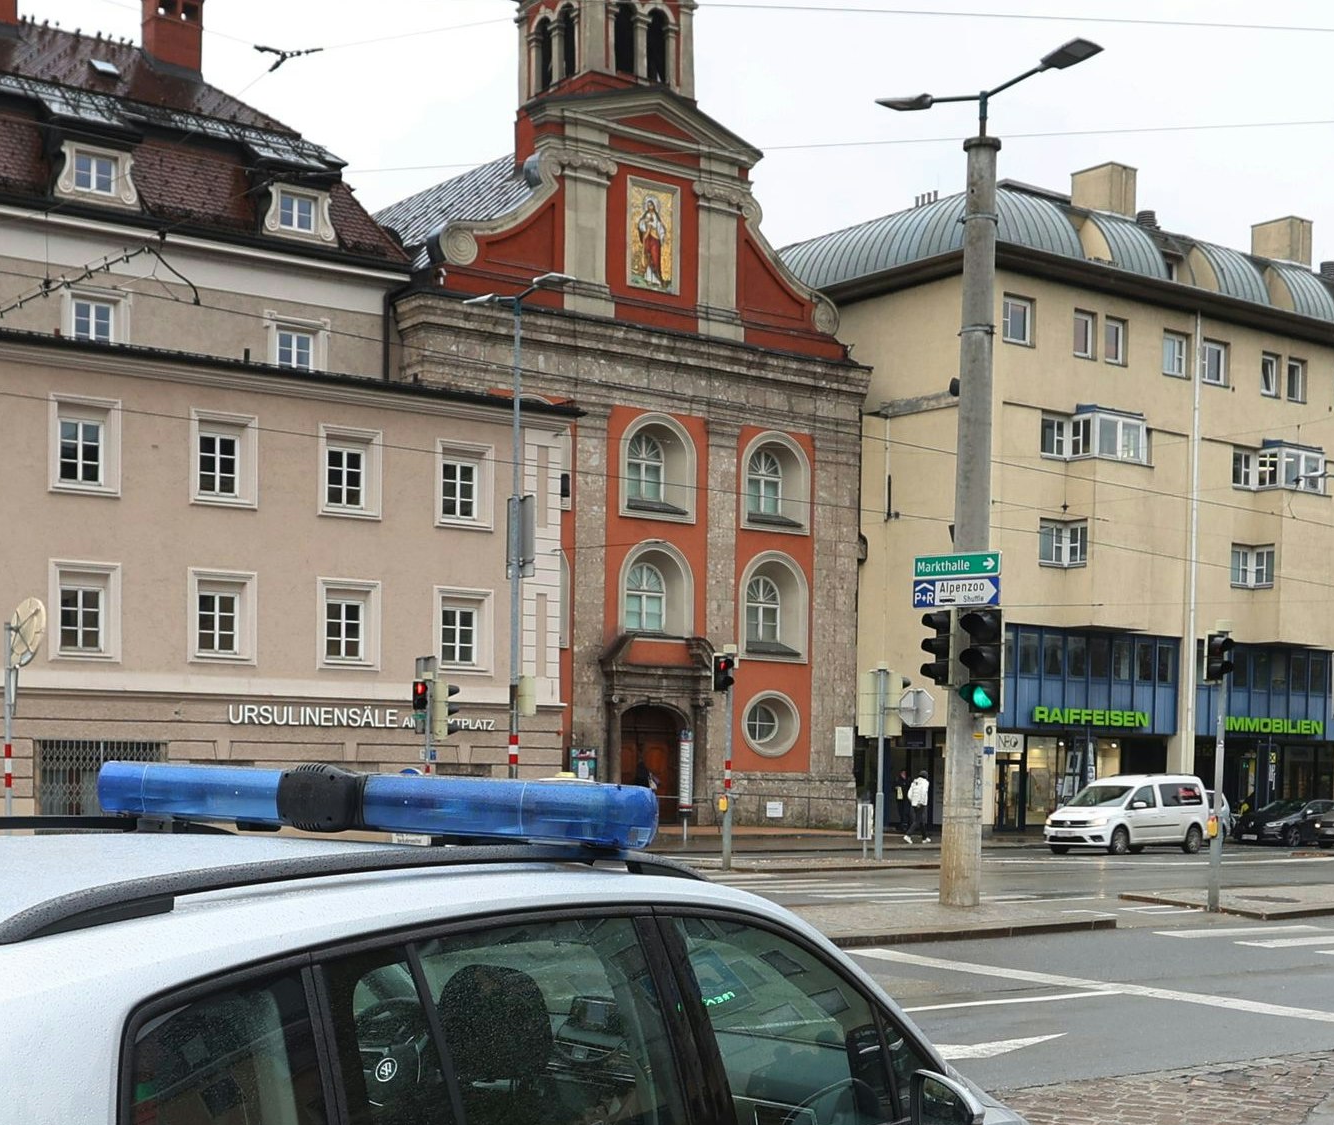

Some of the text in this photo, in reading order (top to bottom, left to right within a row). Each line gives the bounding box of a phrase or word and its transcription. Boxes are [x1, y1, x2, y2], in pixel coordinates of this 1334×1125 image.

[917, 559, 970, 572] Markthalle
[939, 582, 985, 595] Alpenzoo
[914, 592, 934, 604] P+R
[228, 704, 398, 728] URSULINENSÄLE
[1033, 706, 1149, 727] RAIFFEISEN
[1225, 717, 1324, 735] IMMOBILIEN
